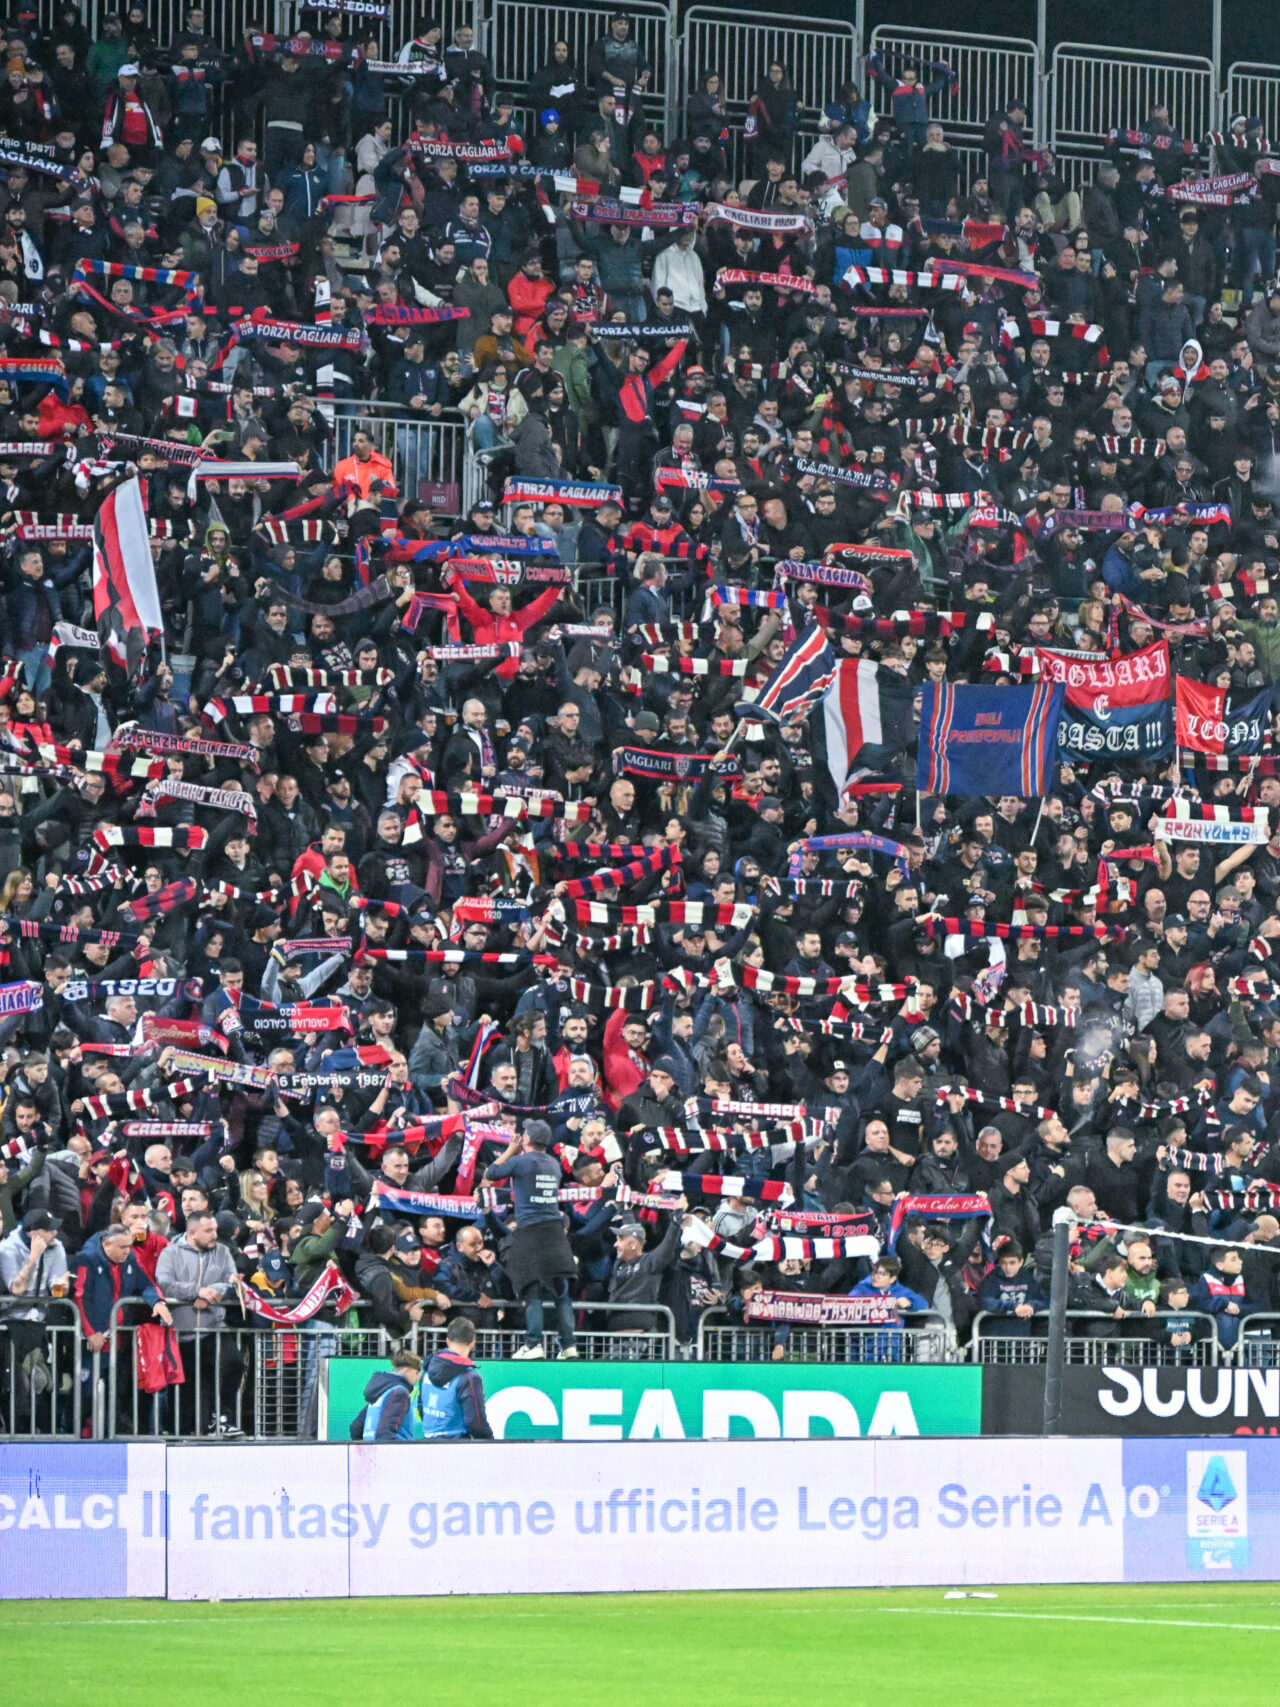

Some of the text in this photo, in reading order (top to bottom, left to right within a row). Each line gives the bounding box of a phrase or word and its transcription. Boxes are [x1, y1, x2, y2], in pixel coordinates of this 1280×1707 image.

[423, 143, 497, 160] FORZA CAGLIARI
[467, 163, 505, 177] FORZA
[1171, 189, 1227, 205] CAGLIARI
[723, 206, 773, 226] CAGLIARI
[256, 323, 342, 345] FORZA CAGLIARI
[594, 326, 634, 338] FORZA
[517, 483, 609, 500] FORZA CAGLIARI
[842, 548, 904, 564] Cagliari
[432, 646, 497, 660] CAGLIARI
[1041, 648, 1167, 689] CAGLIARI
[1093, 692, 1113, 721] E
[1187, 712, 1261, 745] LEONI
[137, 728, 245, 754] FORZA CAGLIARI
[1058, 724, 1141, 751] BASTA
[624, 751, 739, 773] CAGLIARI 120
[1164, 823, 1252, 842] SCONVOLTS
[483, 911, 503, 920] 1920
[100, 978, 177, 996] 1920
[254, 1017, 330, 1030] CAGLIARI CALCIO
[280, 1075, 385, 1090] 6 Febbraio 1987
[718, 1101, 798, 1117] CAGLIARI
[127, 1122, 209, 1136] CAGLIARI
[410, 1194, 459, 1208] CAGLIARI
[821, 1225, 869, 1237] 1920
[189, 1492, 391, 1549] fantasy
[408, 1499, 556, 1549] game
[574, 1486, 780, 1535] ufficiale
[798, 1484, 920, 1542] Lega
[937, 1482, 1063, 1529] Serie
[1078, 1482, 1114, 1528] A
[1196, 1515, 1239, 1527] SERIE A
